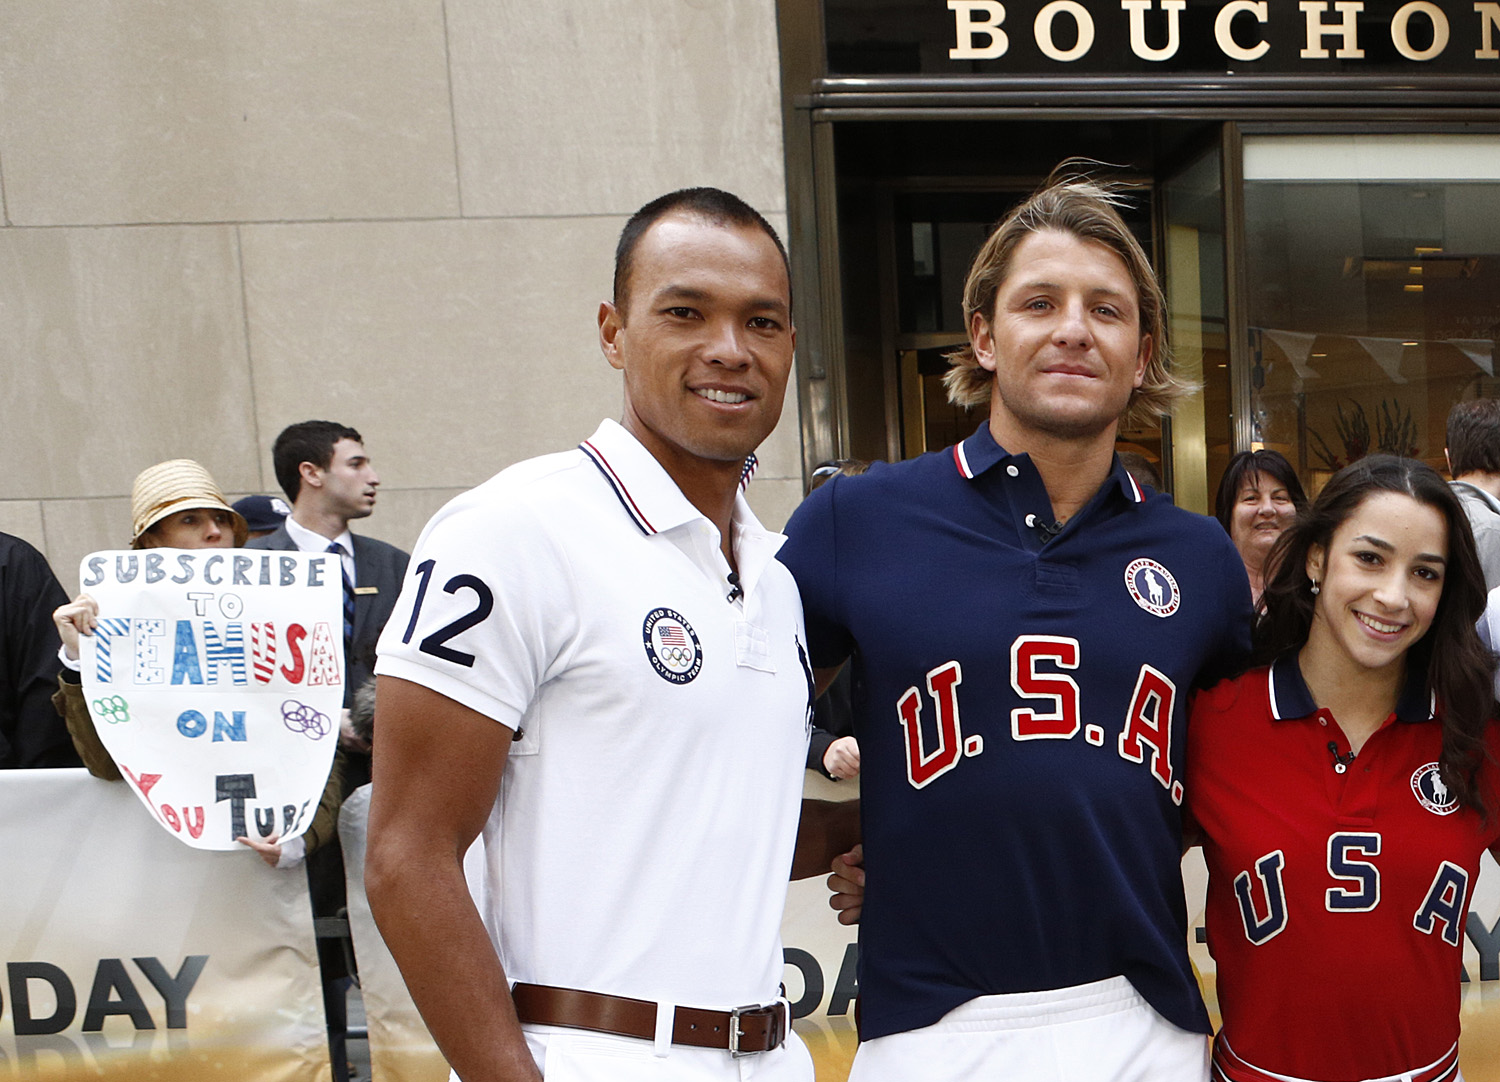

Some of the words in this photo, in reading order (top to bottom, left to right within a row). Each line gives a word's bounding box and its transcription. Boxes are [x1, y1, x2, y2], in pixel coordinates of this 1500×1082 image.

[83, 553, 326, 587] SUBSCRIBE
[187, 592, 243, 619] TO
[402, 559, 494, 668] 12
[645, 609, 665, 634] UNITED
[666, 609, 696, 637] STATES
[651, 656, 686, 682] OLYMPIC
[687, 657, 702, 679] TEAM
[176, 709, 247, 742] ON
[1233, 832, 1470, 948] USA
[0, 954, 210, 1036] DAY
